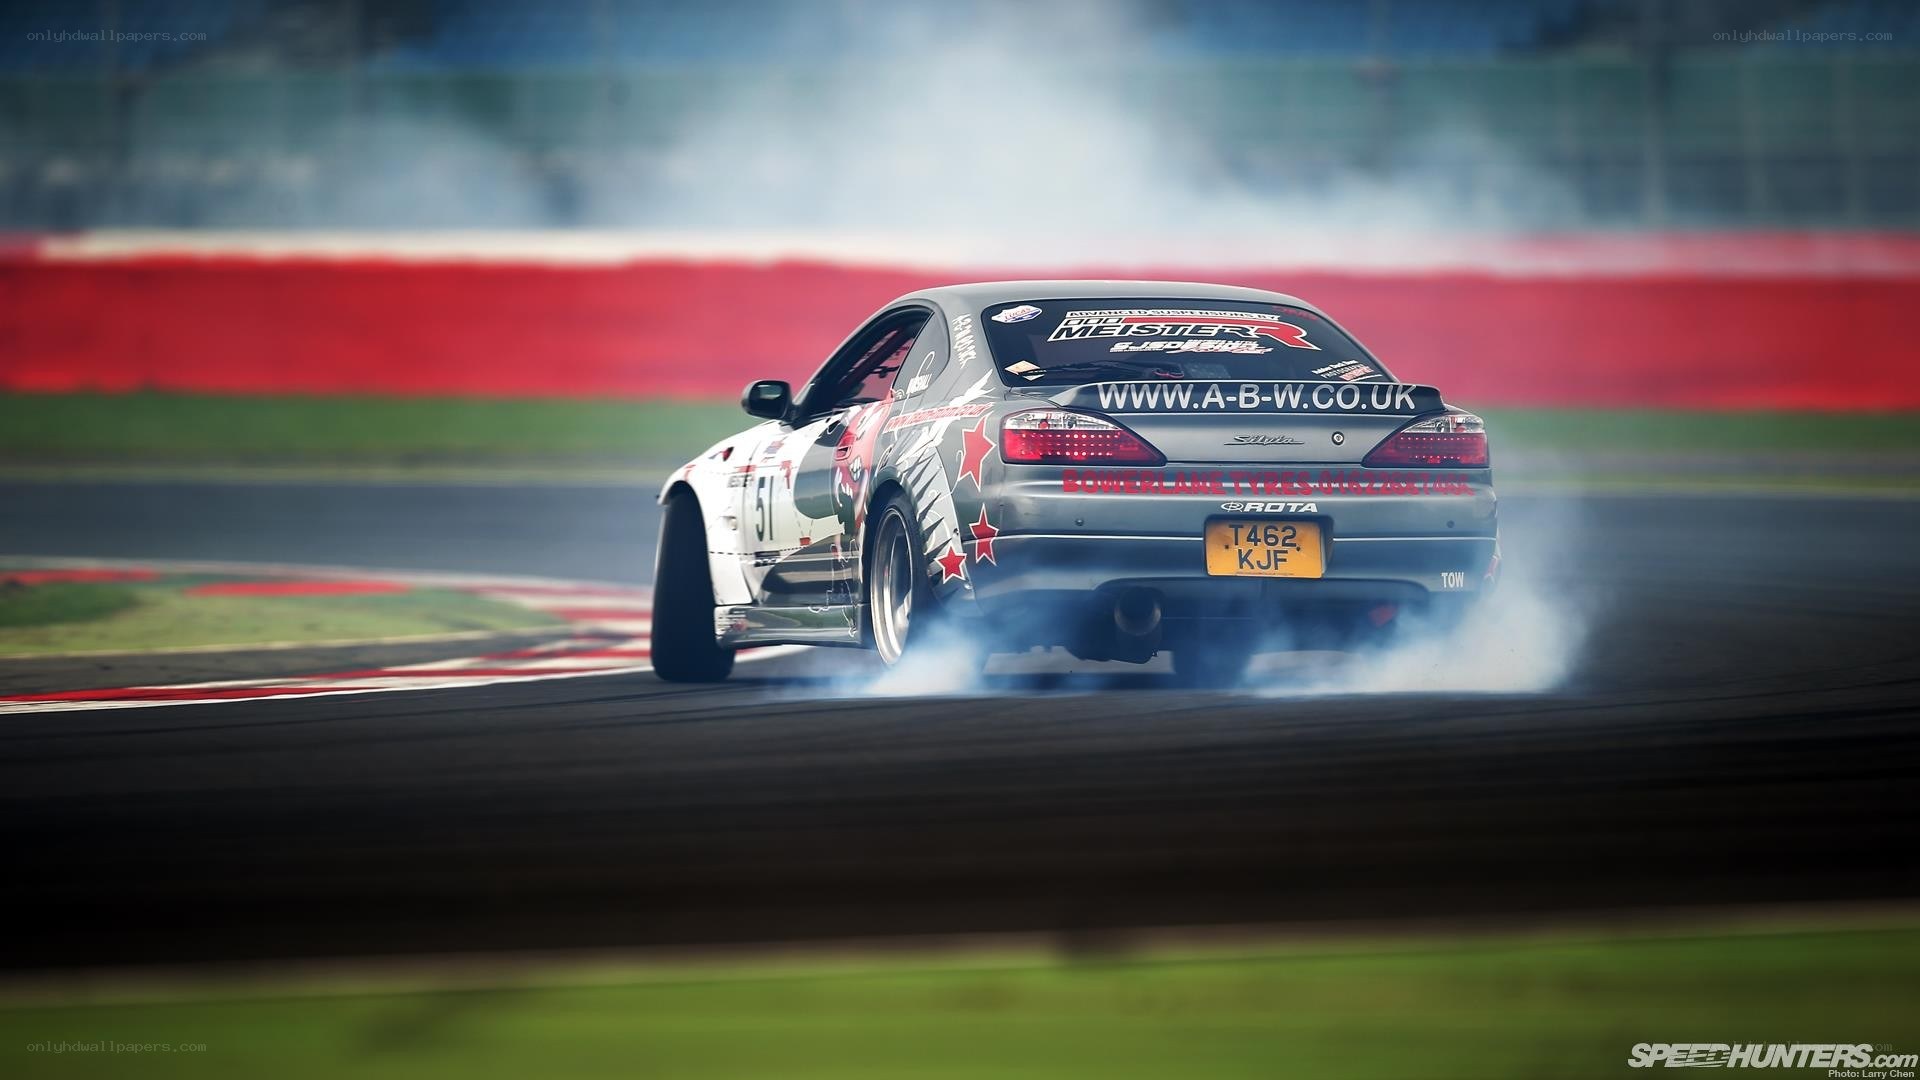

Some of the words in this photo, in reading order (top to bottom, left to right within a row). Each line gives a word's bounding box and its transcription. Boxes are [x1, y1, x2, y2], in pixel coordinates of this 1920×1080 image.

[1096, 382, 1417, 411] WWW.A-B-W.CO.UK
[1224, 434, 1304, 446] Silvia
[756, 475, 775, 542] 51
[1243, 502, 1318, 513] ROTA
[1229, 523, 1297, 547] T462
[1237, 548, 1288, 570] KJF
[1441, 571, 1464, 588] TOW
